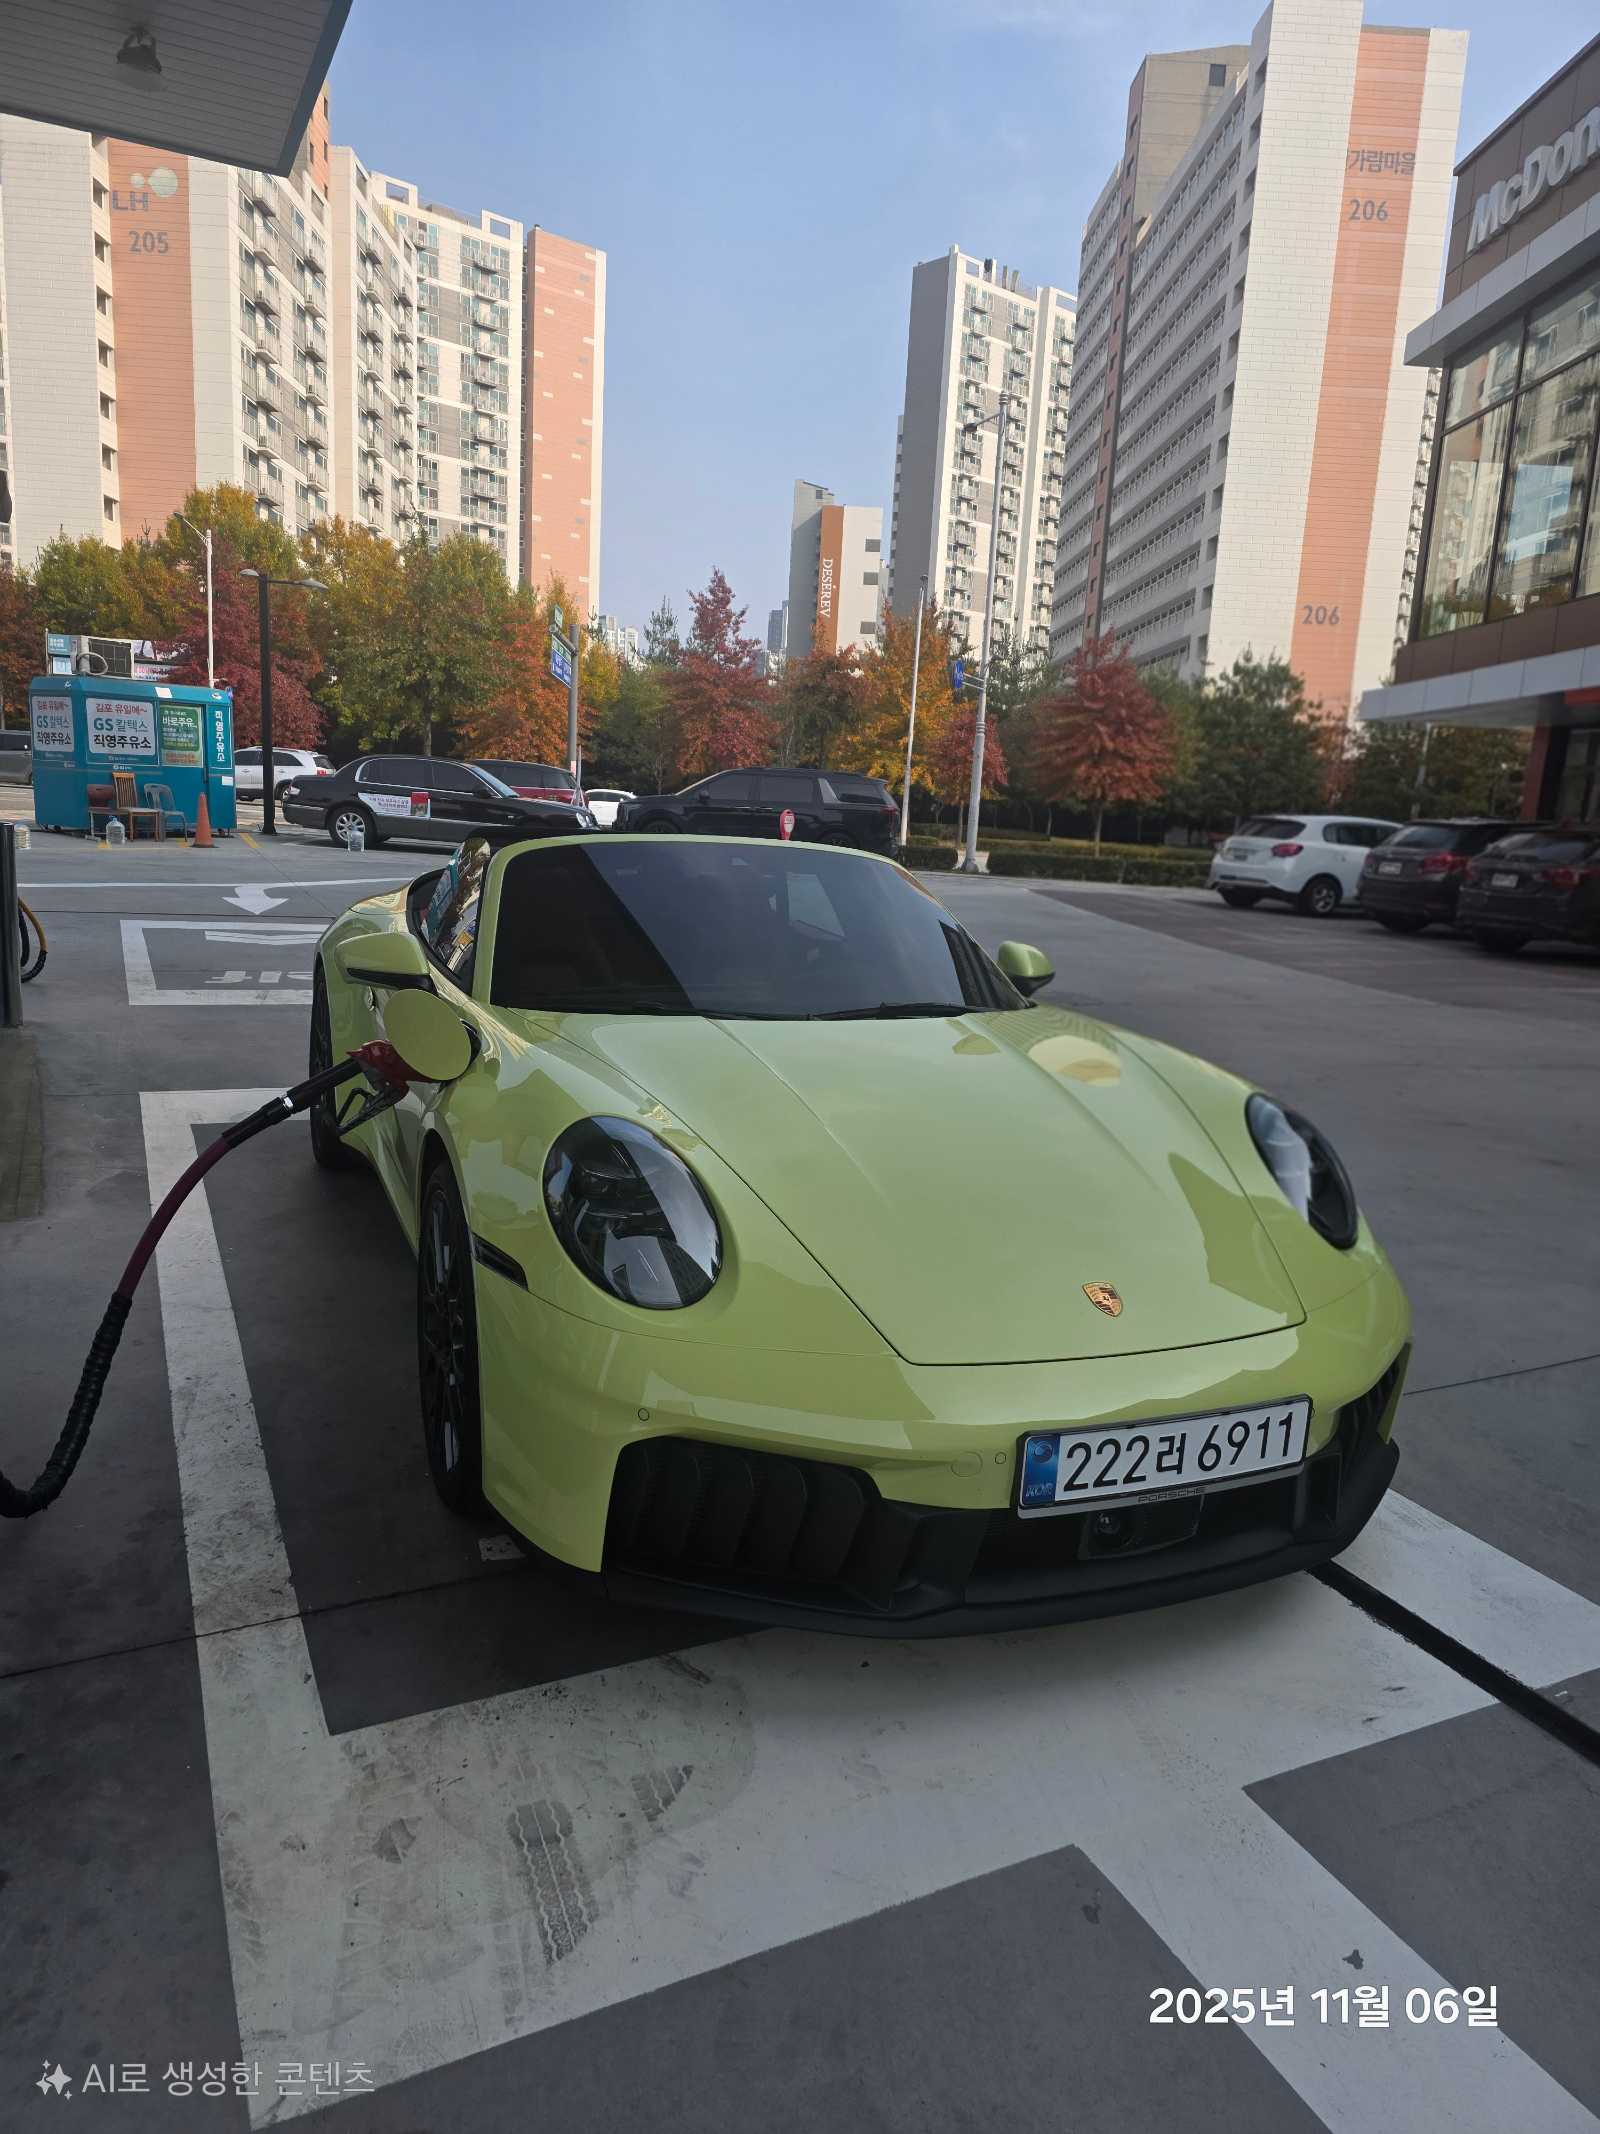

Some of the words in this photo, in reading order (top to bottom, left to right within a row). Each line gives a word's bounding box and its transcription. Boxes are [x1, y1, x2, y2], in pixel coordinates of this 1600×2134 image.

[1345, 149, 1416, 175] 가람마을
[1466, 106, 1600, 253] McDon
[112, 190, 149, 212] LH
[1348, 199, 1388, 221] 206
[128, 230, 169, 254] 205
[1302, 604, 1340, 626] 206
[36, 701, 48, 710] 김포
[95, 703, 113, 713] 김포
[36, 715, 48, 729] GS
[49, 715, 70, 729] 칼텍스
[93, 718, 114, 731] GS
[115, 719, 148, 733] 칼텍스
[36, 731, 72, 745] 직영주유소
[93, 734, 152, 749] 직영주유소
[215, 711, 225, 762] 직영주유소
[1063, 1432, 1187, 1492] 222러
[1198, 1412, 1293, 1472] 6911
[1025, 1482, 1054, 1498] KOR
[1138, 1487, 1206, 1503] PORSCHE
